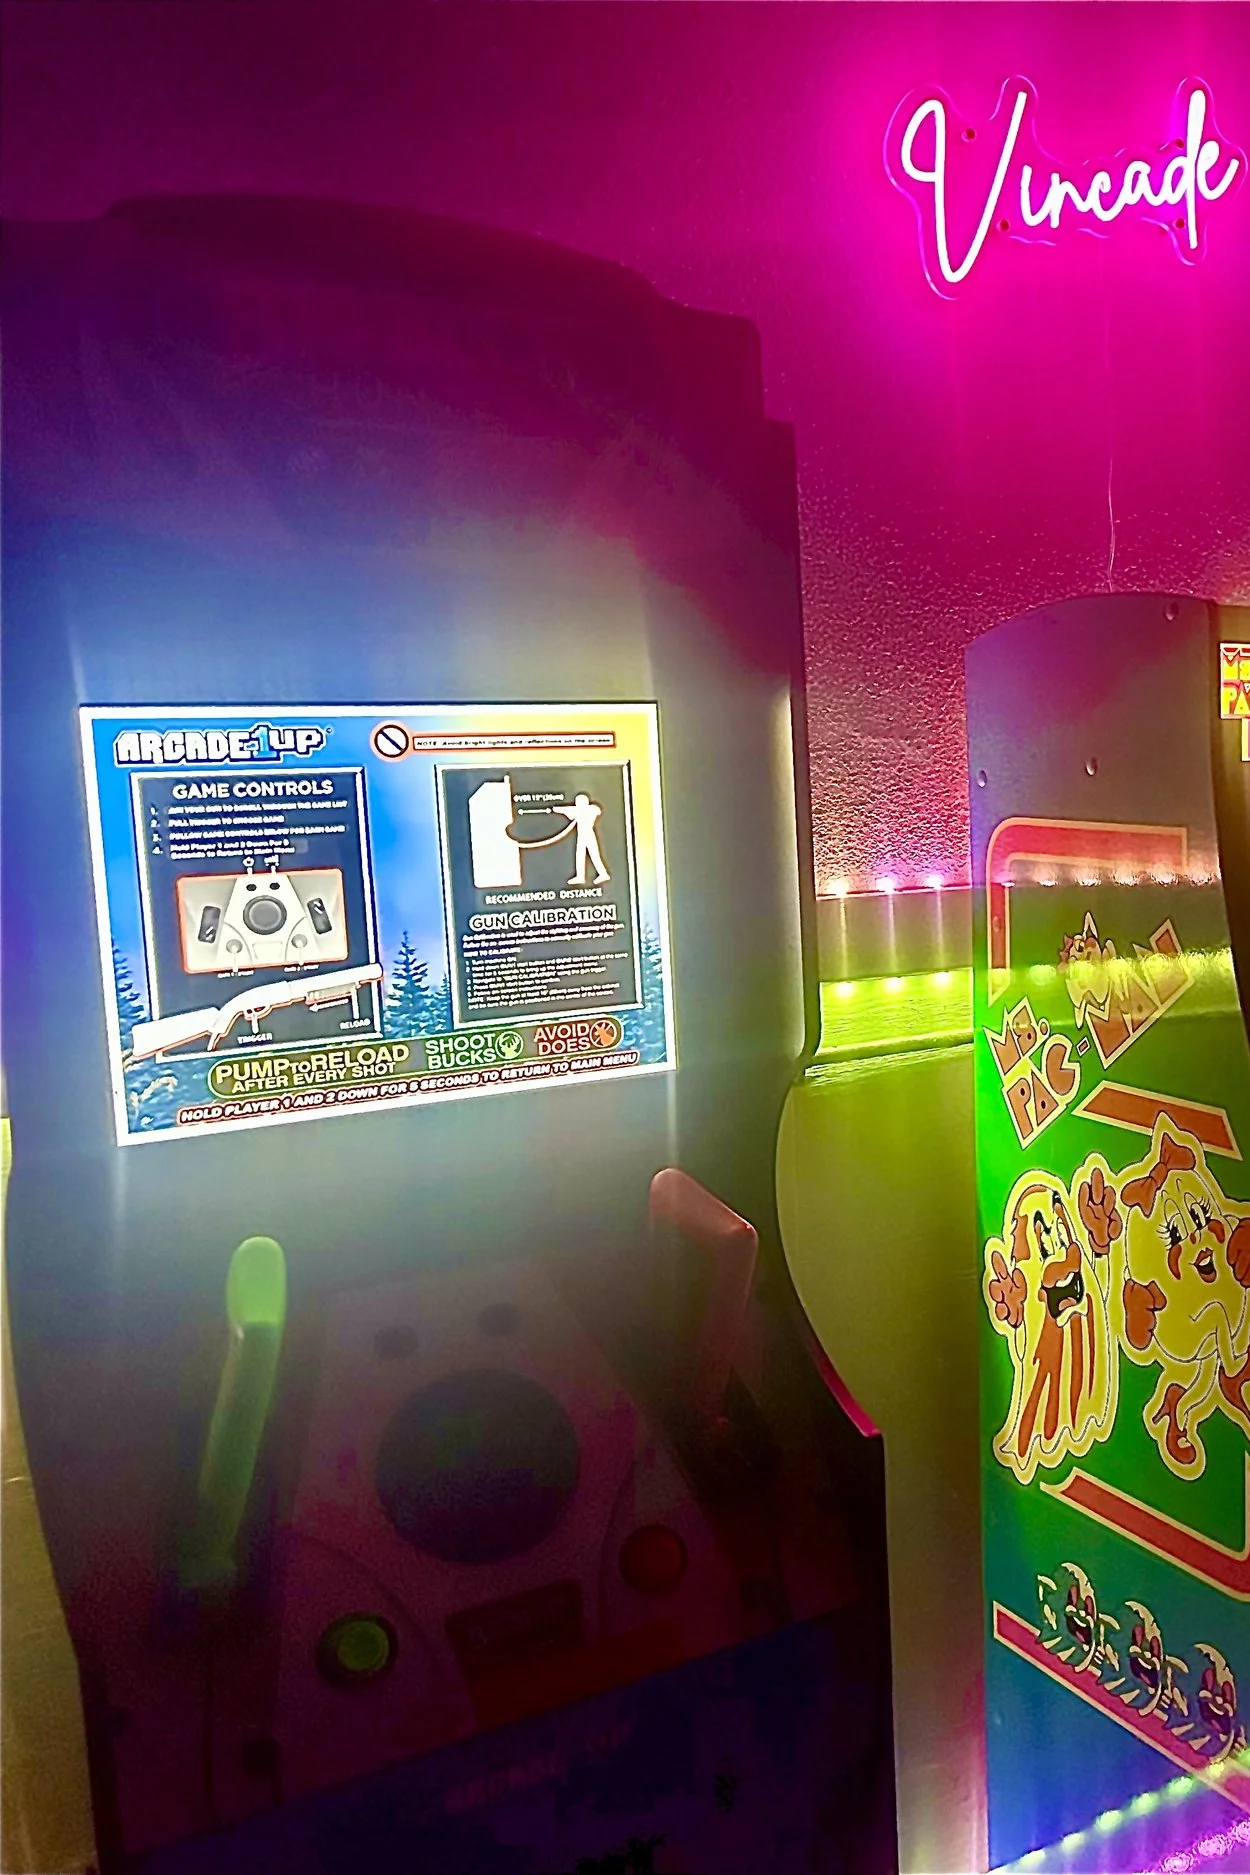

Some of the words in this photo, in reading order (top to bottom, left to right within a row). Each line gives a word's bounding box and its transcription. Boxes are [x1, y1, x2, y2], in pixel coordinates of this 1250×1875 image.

[901, 89, 1239, 283] Vincade
[172, 782, 231, 800] GAME
[232, 779, 334, 799] CONTROLS
[485, 890, 556, 905] RECOMMENDED
[559, 888, 603, 900] DISTANCE
[471, 914, 507, 930] GUN
[510, 906, 615, 928] CALIBRATION
[339, 1018, 371, 1030] RELOAD
[533, 1022, 591, 1043] AVOID
[425, 1033, 496, 1055] SHOOT
[538, 1037, 591, 1056] DOES
[215, 1058, 290, 1084] PUMP
[310, 1045, 410, 1069] RELOAD
[428, 1049, 498, 1070] BUCKS
[180, 1106, 223, 1124] HOLD
[225, 1098, 281, 1117] PLAYER
[282, 1096, 292, 1110] 1
[293, 1092, 324, 1108] AND
[325, 1090, 337, 1103] 2
[338, 1085, 379, 1102] DOWN
[380, 1081, 408, 1097] FOR
[409, 1079, 420, 1093] 5
[419, 1073, 481, 1092] SECONDS
[482, 1070, 500, 1084] TO
[501, 1064, 551, 1081] RETURN
[552, 1061, 570, 1075] TO
[570, 1057, 602, 1072] MAIN
[603, 1052, 638, 1067] MENU
[231, 1075, 289, 1094] AFTER
[293, 1068, 347, 1086] EVERY
[351, 1062, 397, 1078] SHOT
